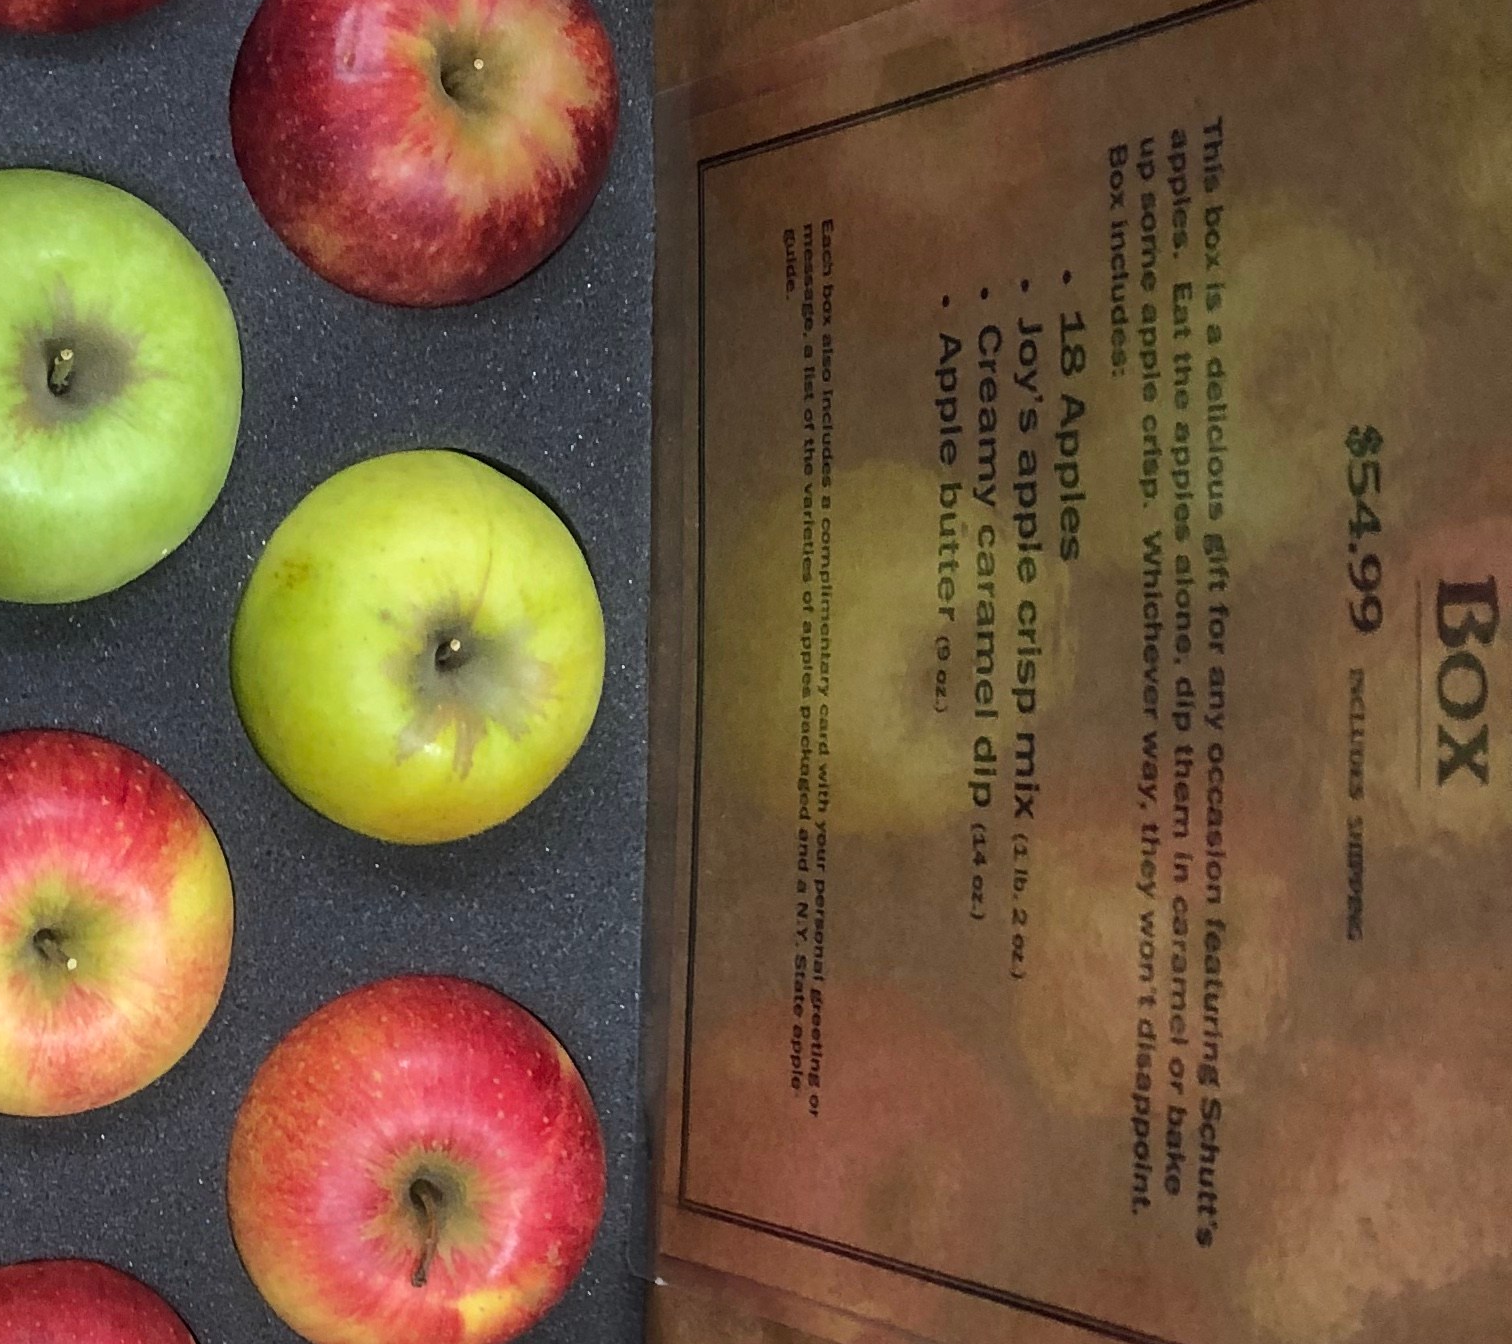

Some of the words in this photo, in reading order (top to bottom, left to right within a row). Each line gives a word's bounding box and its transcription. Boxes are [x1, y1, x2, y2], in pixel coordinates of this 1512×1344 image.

[1107, 144, 1129, 209] Box
[1136, 136, 1157, 182] up
[1204, 115, 1224, 193] This
[1167, 128, 1192, 259] apples.
[783, 228, 797, 301] guide.
[821, 218, 835, 277] Each
[1140, 191, 1157, 293] some
[1204, 206, 1224, 271] box
[801, 224, 814, 338] message,
[822, 284, 834, 326] box
[1110, 220, 1129, 379] includes:
[1172, 281, 1193, 340] Eat
[1206, 282, 1226, 313] is
[804, 345, 813, 358] a
[822, 333, 834, 383] also
[1060, 311, 1087, 377] 18
[1137, 303, 1162, 402] apple
[1207, 324, 1223, 345] a
[803, 366, 815, 401] list
[935, 332, 963, 465] Apple
[1014, 317, 1044, 434] Joy's
[1173, 351, 1193, 410] the
[803, 408, 815, 431] of
[973, 324, 1003, 508] Creamy
[1207, 357, 1228, 521] delicious
[803, 438, 815, 476] the
[1054, 393, 1087, 562] Apples
[1139, 414, 1162, 509] crisp.
[1170, 422, 1194, 543] apples
[802, 484, 815, 583] varieties
[822, 495, 832, 509] a
[1013, 449, 1043, 584] apple
[1345, 424, 1384, 637] $54.99
[938, 482, 963, 622] butter
[1203, 533, 1230, 592] gift
[802, 591, 813, 613] of
[818, 517, 833, 697] complimentary
[975, 524, 999, 719] caramel
[1142, 531, 1163, 721] Whichever
[1173, 555, 1195, 665] alone,
[1209, 605, 1230, 655] for
[800, 621, 813, 698] apples
[935, 635, 952, 661] (9
[1012, 600, 1042, 715] crisp
[934, 669, 950, 714] oz.)
[1171, 676, 1195, 732] dip
[1205, 666, 1226, 730] any
[797, 706, 813, 821] packaged
[818, 704, 830, 756] card
[1348, 668, 1365, 800] INCLUDES
[818, 763, 830, 813] with
[968, 735, 997, 807] dip
[1014, 732, 1040, 821] mix
[1137, 731, 1158, 811] way,
[1173, 745, 1195, 839] them
[797, 827, 809, 872] and
[815, 820, 828, 872] your
[970, 822, 988, 866] (14
[1205, 742, 1227, 905] occasion
[796, 878, 808, 893] a
[969, 874, 987, 921] oz.)
[1136, 823, 1162, 899] they
[1172, 851, 1194, 884] in
[795, 903, 808, 947] N.Y.
[812, 878, 827, 981] personal
[1013, 908, 1028, 926] 2
[793, 955, 808, 1019] State
[1137, 910, 1157, 1008] won't
[1168, 895, 1190, 1046] caramel
[807, 989, 823, 1089] greeting
[1197, 918, 1227, 1088] featuring
[809, 1094, 820, 1118] or
[1168, 1057, 1186, 1096] or
[1131, 1018, 1158, 1216] disappoint.
[1163, 1105, 1188, 1197] bake
[1194, 1096, 1222, 1249] Schutt's
